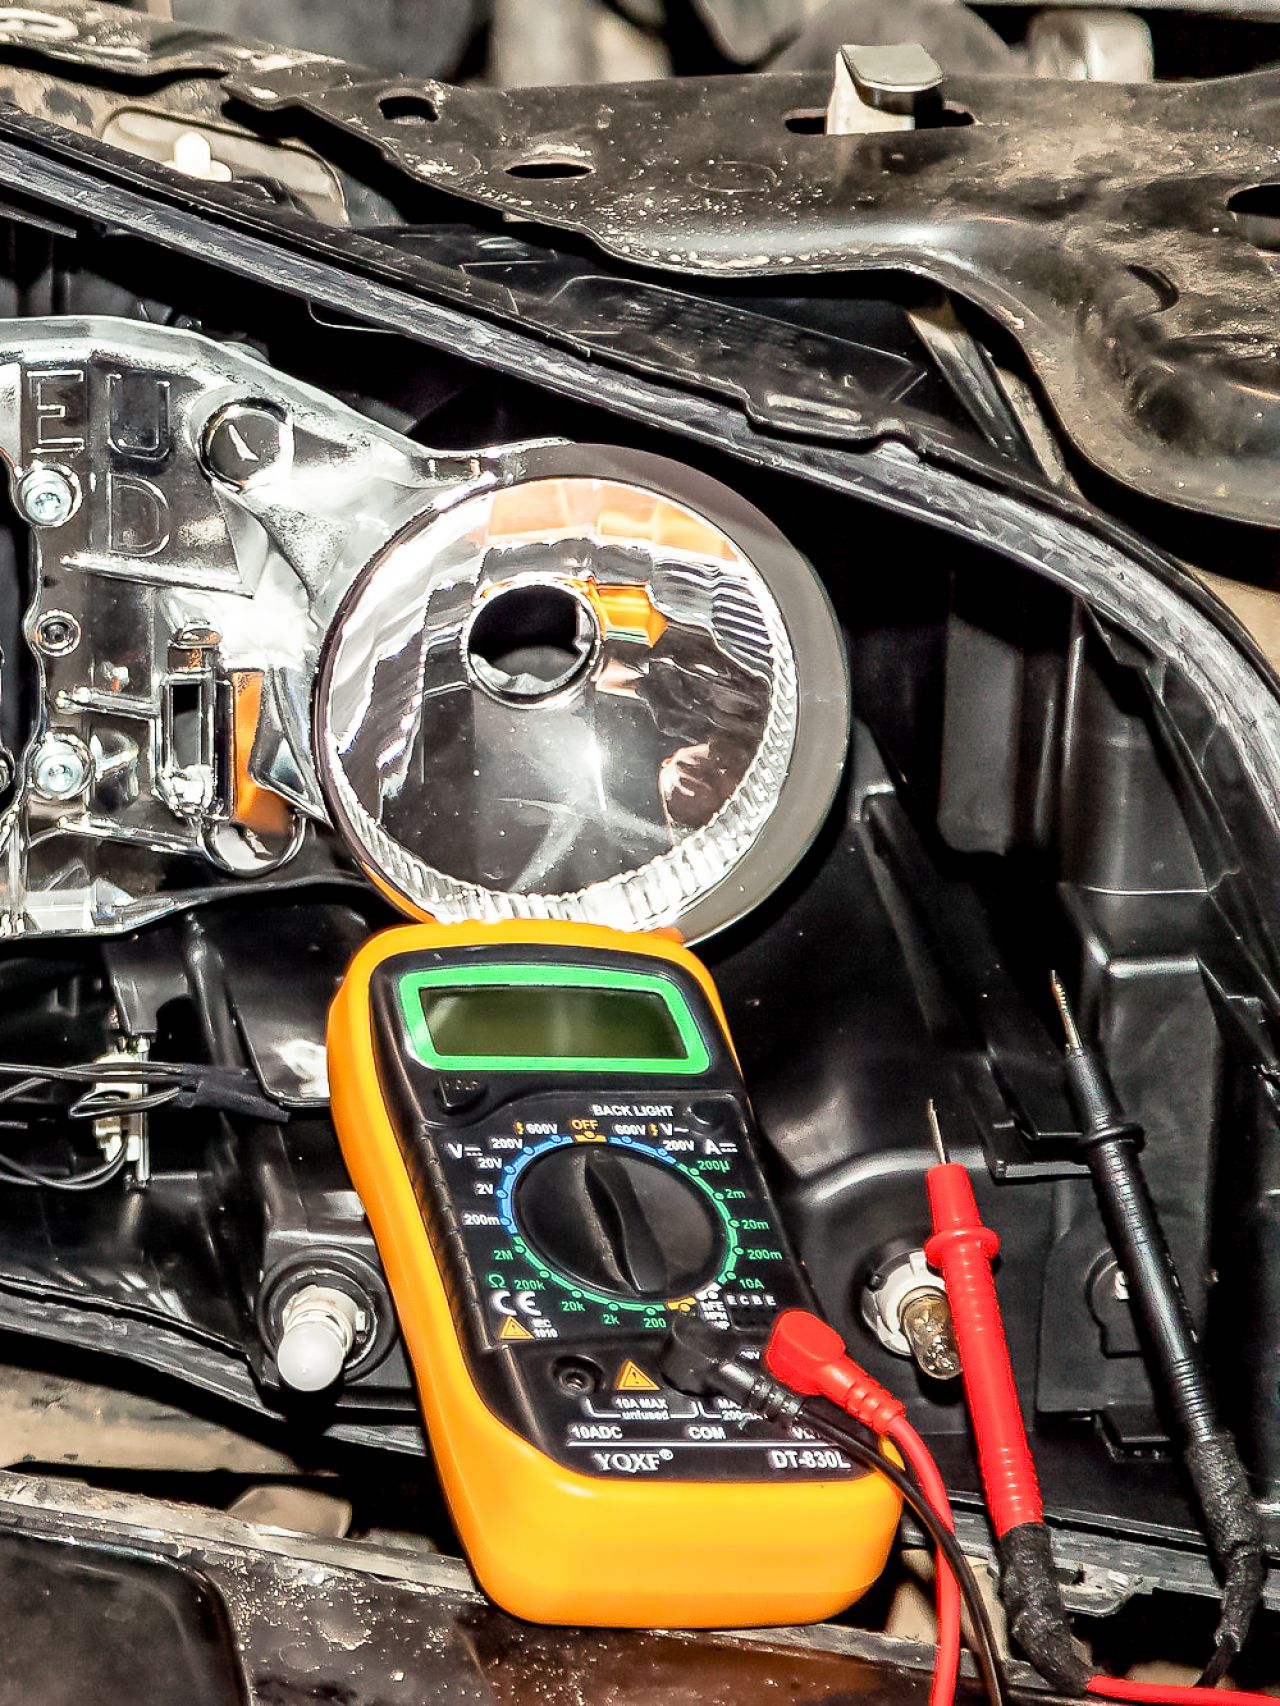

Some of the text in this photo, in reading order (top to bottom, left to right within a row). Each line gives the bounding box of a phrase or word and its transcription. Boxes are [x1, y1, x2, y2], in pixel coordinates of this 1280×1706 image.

[593, 1105, 674, 1117] BACK LIGHT
[525, 1122, 559, 1135] 600V
[571, 1119, 599, 1131] OFF
[614, 1124, 646, 1136] 600V
[491, 1138, 523, 1149] 200V
[663, 1140, 695, 1152] 200V
[478, 1158, 502, 1169] 20V
[476, 1183, 494, 1195] 2V
[725, 1188, 746, 1199] 2m
[463, 1214, 500, 1226] 200m
[742, 1219, 770, 1231] 20m
[493, 1250, 514, 1261] 2M
[747, 1249, 783, 1261] 200m
[513, 1280, 546, 1291] 200k
[739, 1278, 765, 1290] 10A
[561, 1301, 586, 1313] 20k
[603, 1315, 619, 1325] 2k
[643, 1318, 667, 1329] 200
[615, 1398, 669, 1410] 10A MAX
[622, 1409, 670, 1421] unfused
[571, 1426, 623, 1440] 10ADC
[688, 1426, 727, 1440] COM
[770, 1450, 852, 1470] DT-830L
